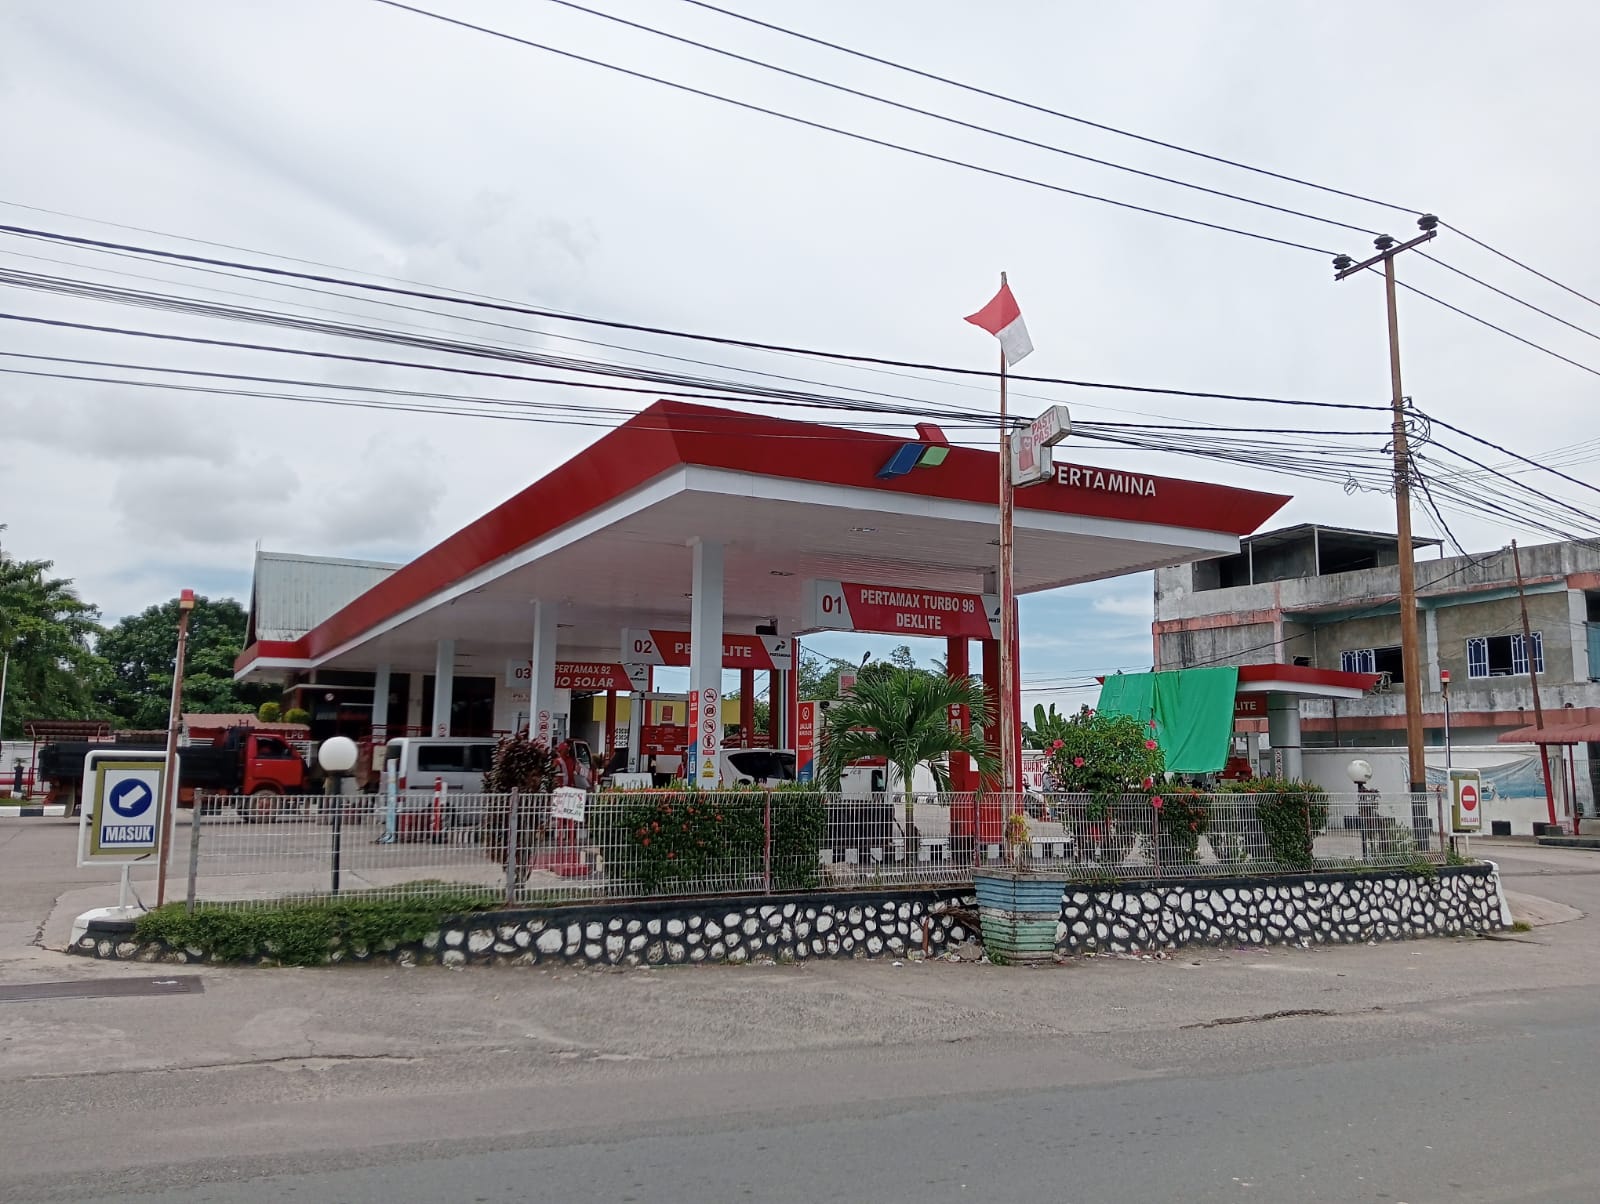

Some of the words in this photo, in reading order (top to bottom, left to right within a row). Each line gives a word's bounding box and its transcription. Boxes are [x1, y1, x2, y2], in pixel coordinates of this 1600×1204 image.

[1032, 410, 1055, 435] PASTI
[1034, 424, 1053, 446] PAS!
[822, 595, 842, 614] 01
[860, 589, 920, 609] PERTAMAX
[923, 595, 960, 612] TURBO
[962, 599, 975, 613] 98
[896, 613, 941, 630] DEXLITE
[634, 640, 653, 654] 02
[515, 668, 531, 679] 03
[555, 664, 599, 675] PERTAMAX
[601, 666, 611, 675] 92
[573, 678, 614, 688] SOLAR
[1235, 701, 1257, 711] LITE
[285, 731, 304, 739] LPG
[105, 826, 152, 841] MASUK
